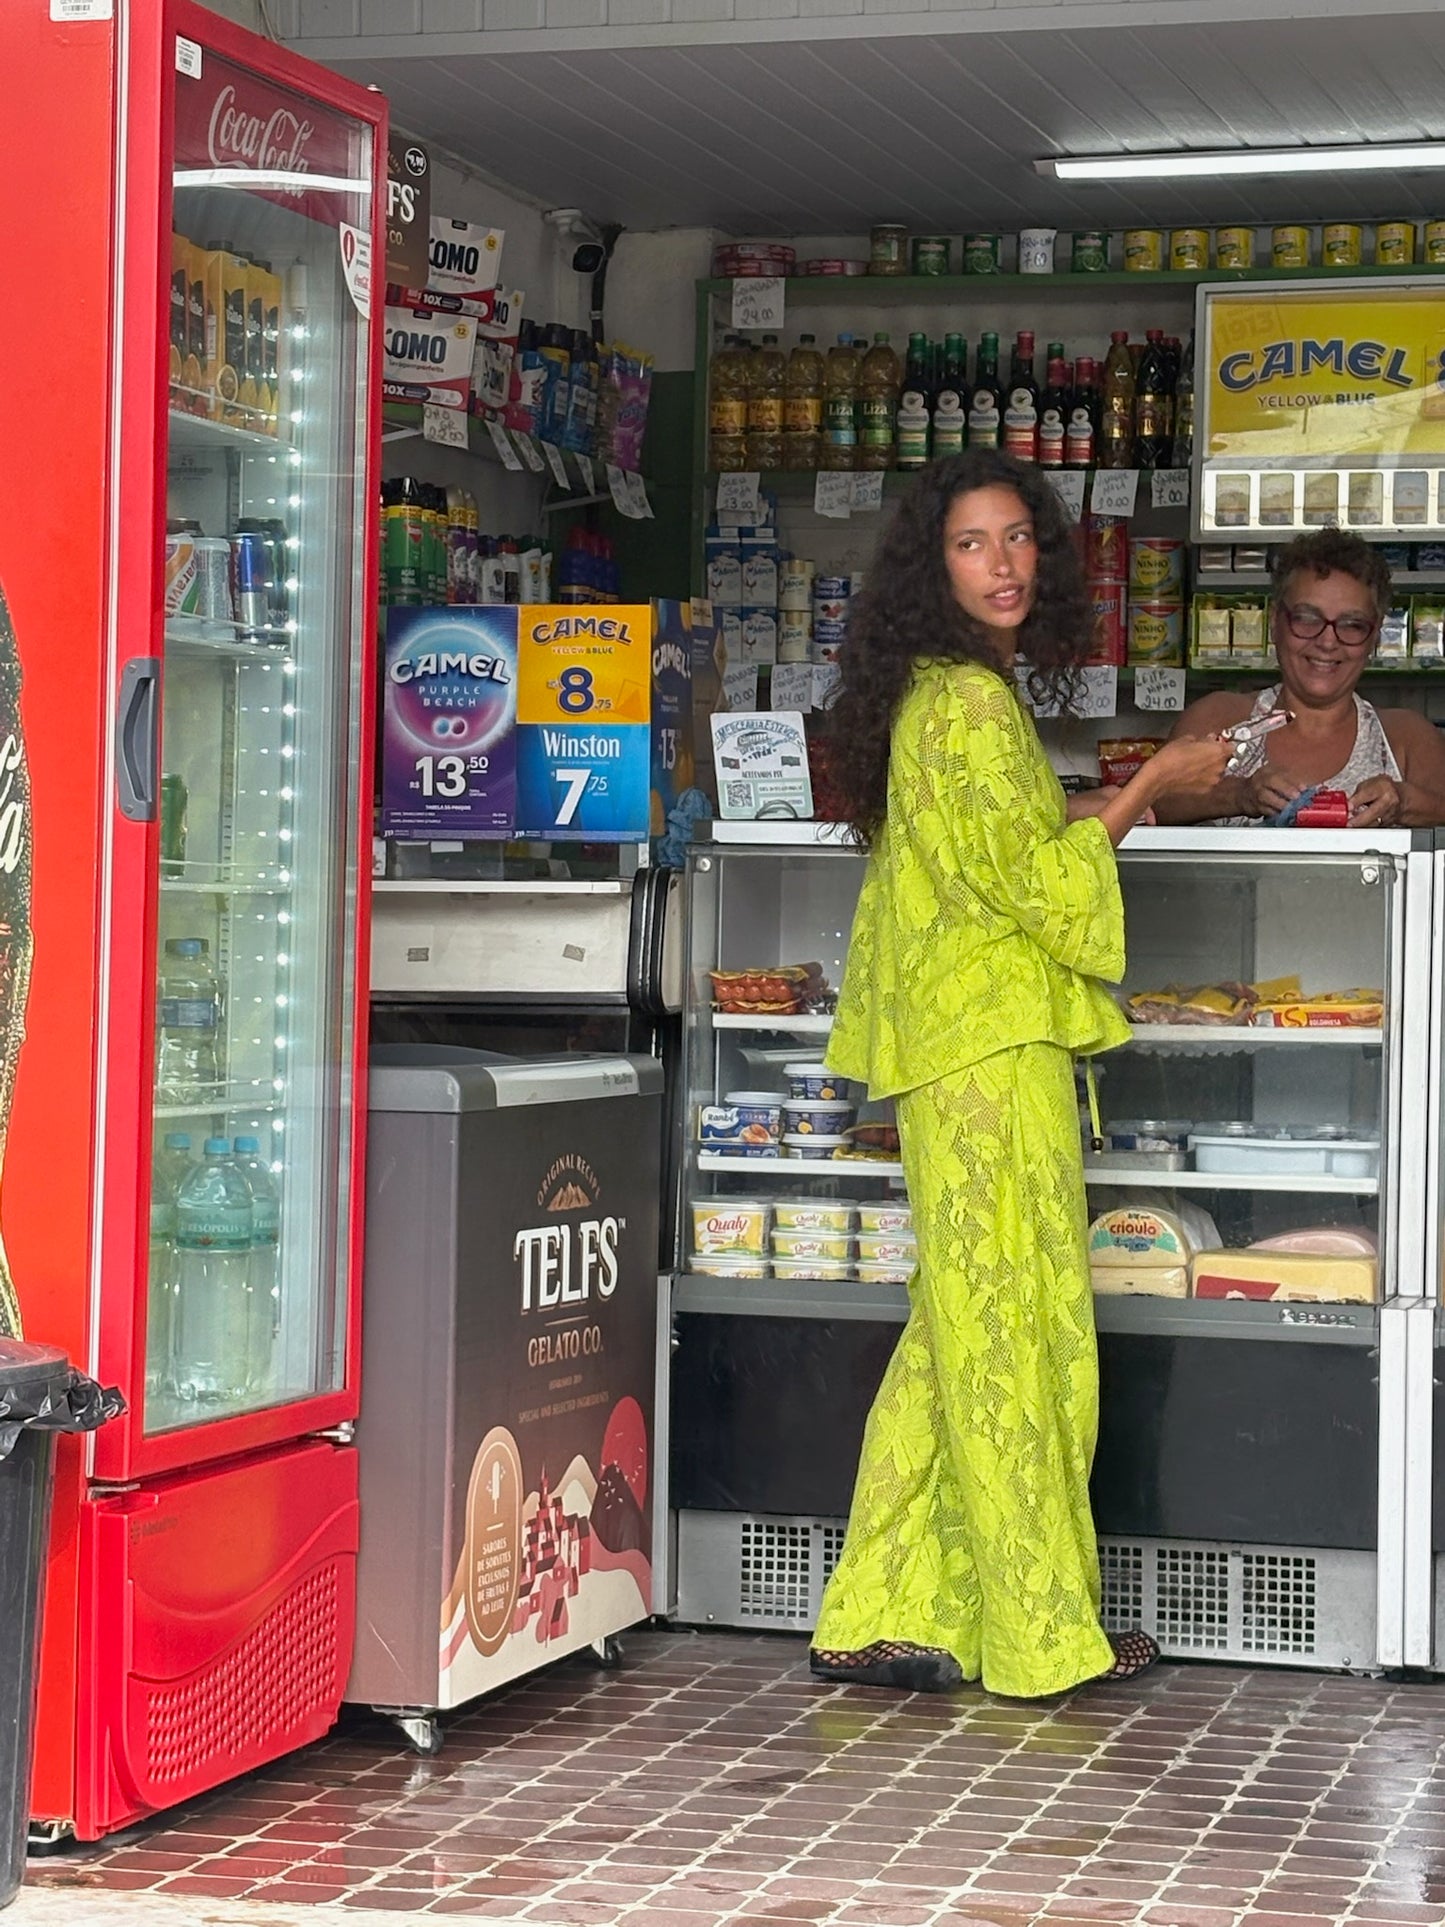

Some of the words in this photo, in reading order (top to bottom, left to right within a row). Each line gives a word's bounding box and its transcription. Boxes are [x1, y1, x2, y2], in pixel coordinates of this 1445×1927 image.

[386, 180, 415, 223] FS
[434, 240, 479, 275] OMO
[423, 293, 442, 306] 10X
[391, 329, 447, 364] OMO
[1218, 338, 1414, 391] CAMEL
[382, 384, 405, 396] 10X
[863, 403, 888, 415] Liza
[1258, 394, 1321, 407] YELLOW
[1335, 393, 1376, 406] BLUE
[829, 404, 854, 416] Liza
[1137, 559, 1168, 569] NINHO
[532, 618, 632, 645] CAMEL
[1134, 624, 1165, 633] NINHO
[552, 647, 585, 655] YELLOW
[592, 647, 613, 655] BLUE
[390, 653, 511, 684] CAMEL
[653, 643, 691, 679] CAMEL
[419, 686, 480, 695] PURPLE
[423, 697, 477, 707] BEACH
[543, 729, 620, 758] Winston
[537, 1153, 575, 1206] ORIGINAL
[576, 1154, 601, 1200] RECIPE
[706, 1216, 749, 1234] Qualy
[515, 1216, 619, 1312] TELFS
[528, 1329, 580, 1367] GELATO
[583, 1325, 604, 1354] CO.
[518, 1407, 540, 1424] SPECIAL
[482, 1537, 507, 1555] SABORES
[477, 1560, 485, 1572] DE
[485, 1550, 512, 1570] SORVETES
[477, 1590, 485, 1603] DE
[485, 1582, 505, 1599] FRUTAS
[481, 1603, 491, 1616] AO
[490, 1597, 505, 1613] LEITE
